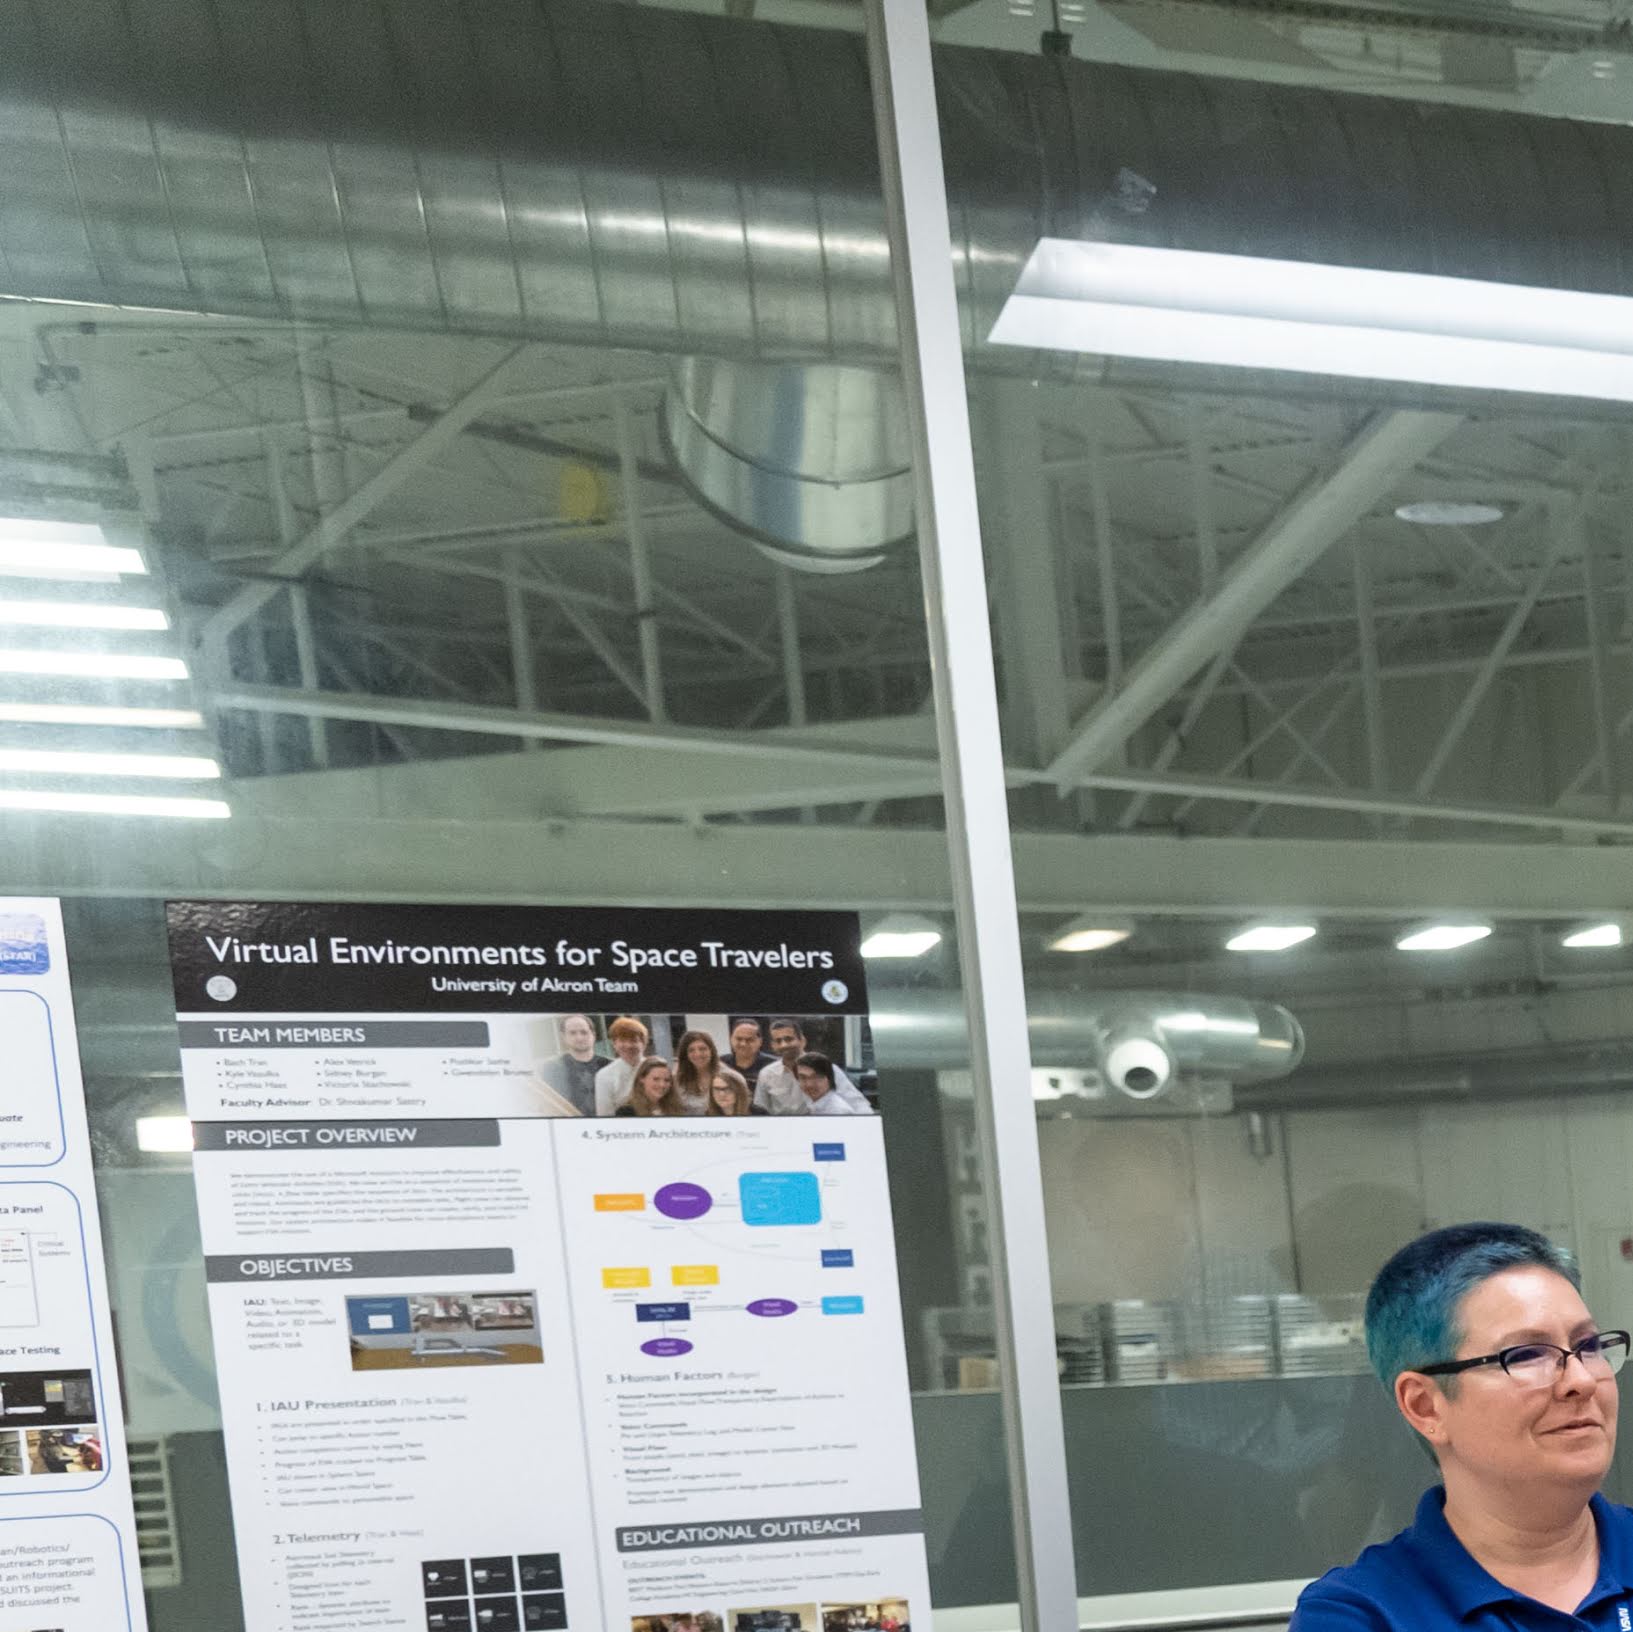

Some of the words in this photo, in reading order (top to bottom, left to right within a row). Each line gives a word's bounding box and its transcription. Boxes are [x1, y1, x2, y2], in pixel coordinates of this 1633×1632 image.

[206, 937, 316, 964] Virtual
[330, 937, 546, 965] Environments
[557, 941, 601, 966] for
[612, 941, 697, 973] Space
[702, 942, 834, 969] Travelers
[432, 977, 515, 995] University
[522, 977, 540, 992] of
[541, 978, 592, 993] Akron
[596, 978, 638, 993] Team
[214, 1028, 271, 1044] TEAM
[276, 1027, 366, 1043] MEMBERS
[221, 1098, 263, 1108] Faculty
[225, 1129, 310, 1147] PROJECT
[316, 1128, 417, 1144] OVERVIEW
[596, 1130, 646, 1141] System
[649, 1129, 732, 1140] Architecture
[13, 1205, 43, 1214] Panel
[240, 1257, 353, 1277] OBJECTIVES
[20, 1346, 61, 1355] Testing
[620, 1374, 671, 1384] Human
[674, 1372, 724, 1381] Factors
[270, 1400, 300, 1413] IAU
[305, 1398, 397, 1412] Presentation
[288, 1532, 361, 1546] Telemetry
[622, 1523, 754, 1547] EDUCATIONAL
[760, 1517, 861, 1539] OUTREACH
[48, 1556, 94, 1567] program
[622, 1554, 688, 1570] Educational
[690, 1552, 745, 1567] Outreach
[1617, 1607, 1632, 1632] NASA
